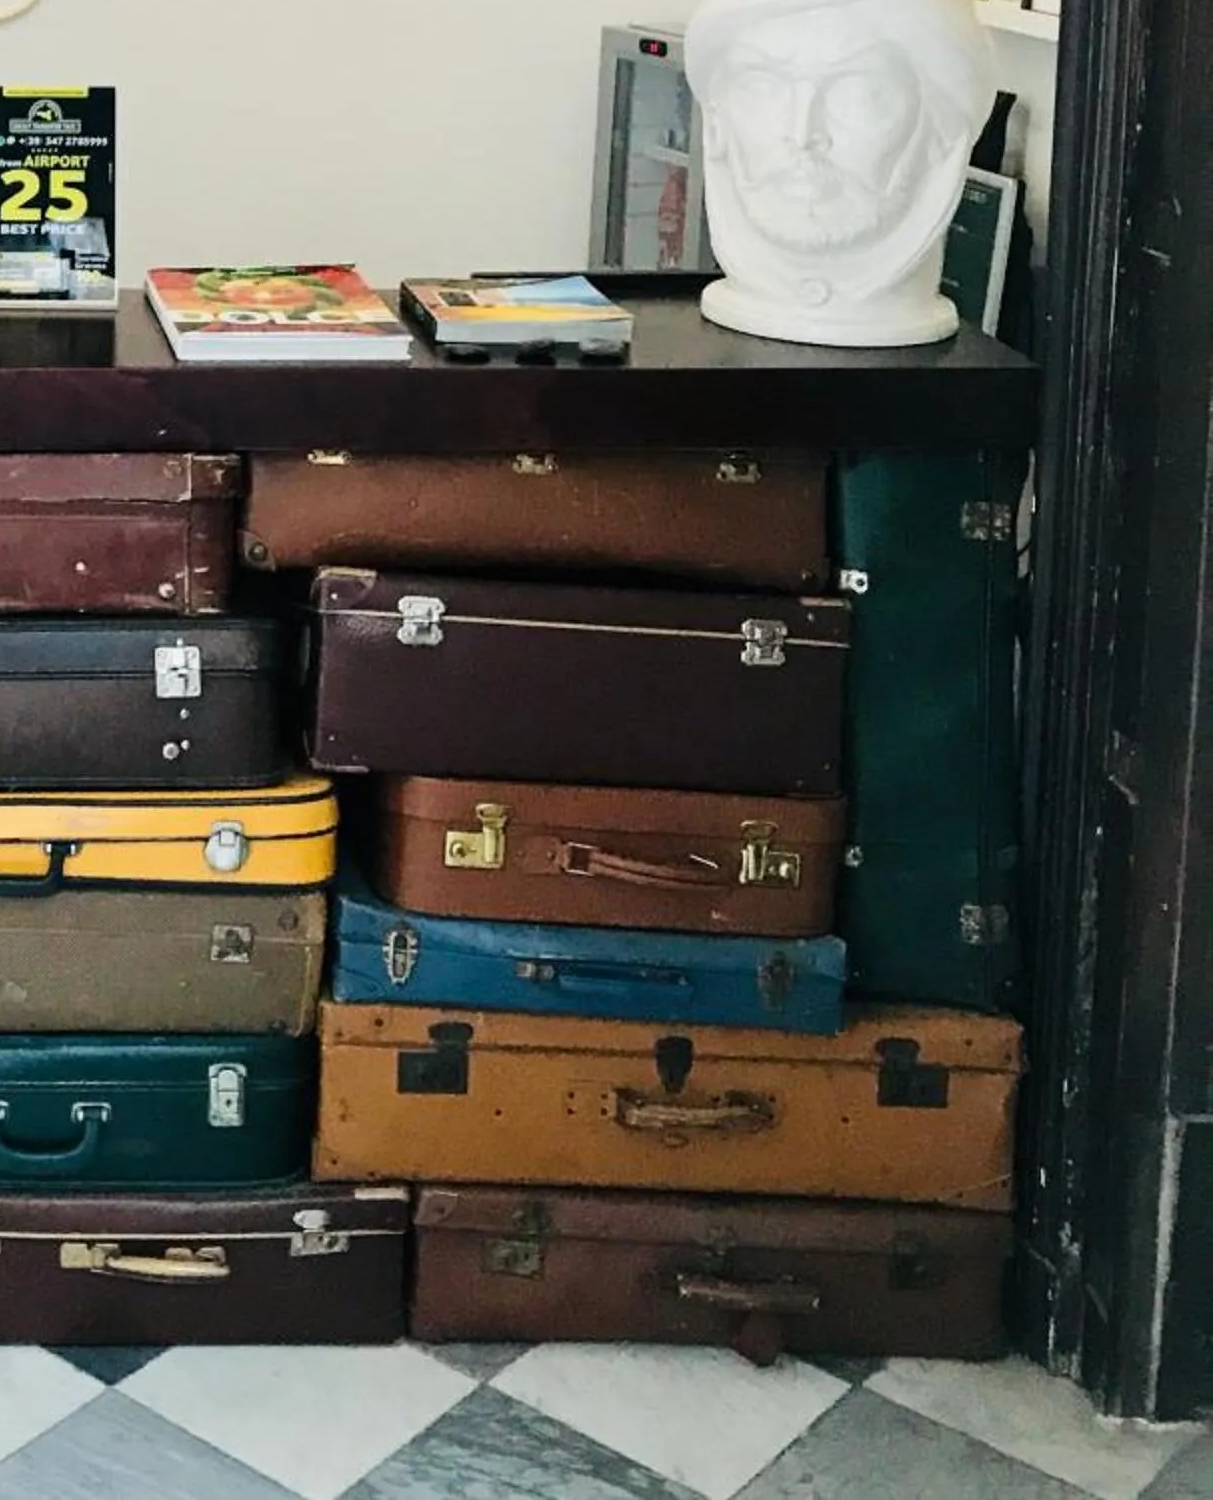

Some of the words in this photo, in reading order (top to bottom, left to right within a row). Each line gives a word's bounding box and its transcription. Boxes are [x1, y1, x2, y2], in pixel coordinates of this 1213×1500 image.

[23, 154, 91, 168] AIRPORT
[0, 169, 88, 222] 25
[0, 223, 37, 236] BEST
[40, 223, 85, 236] PRICE
